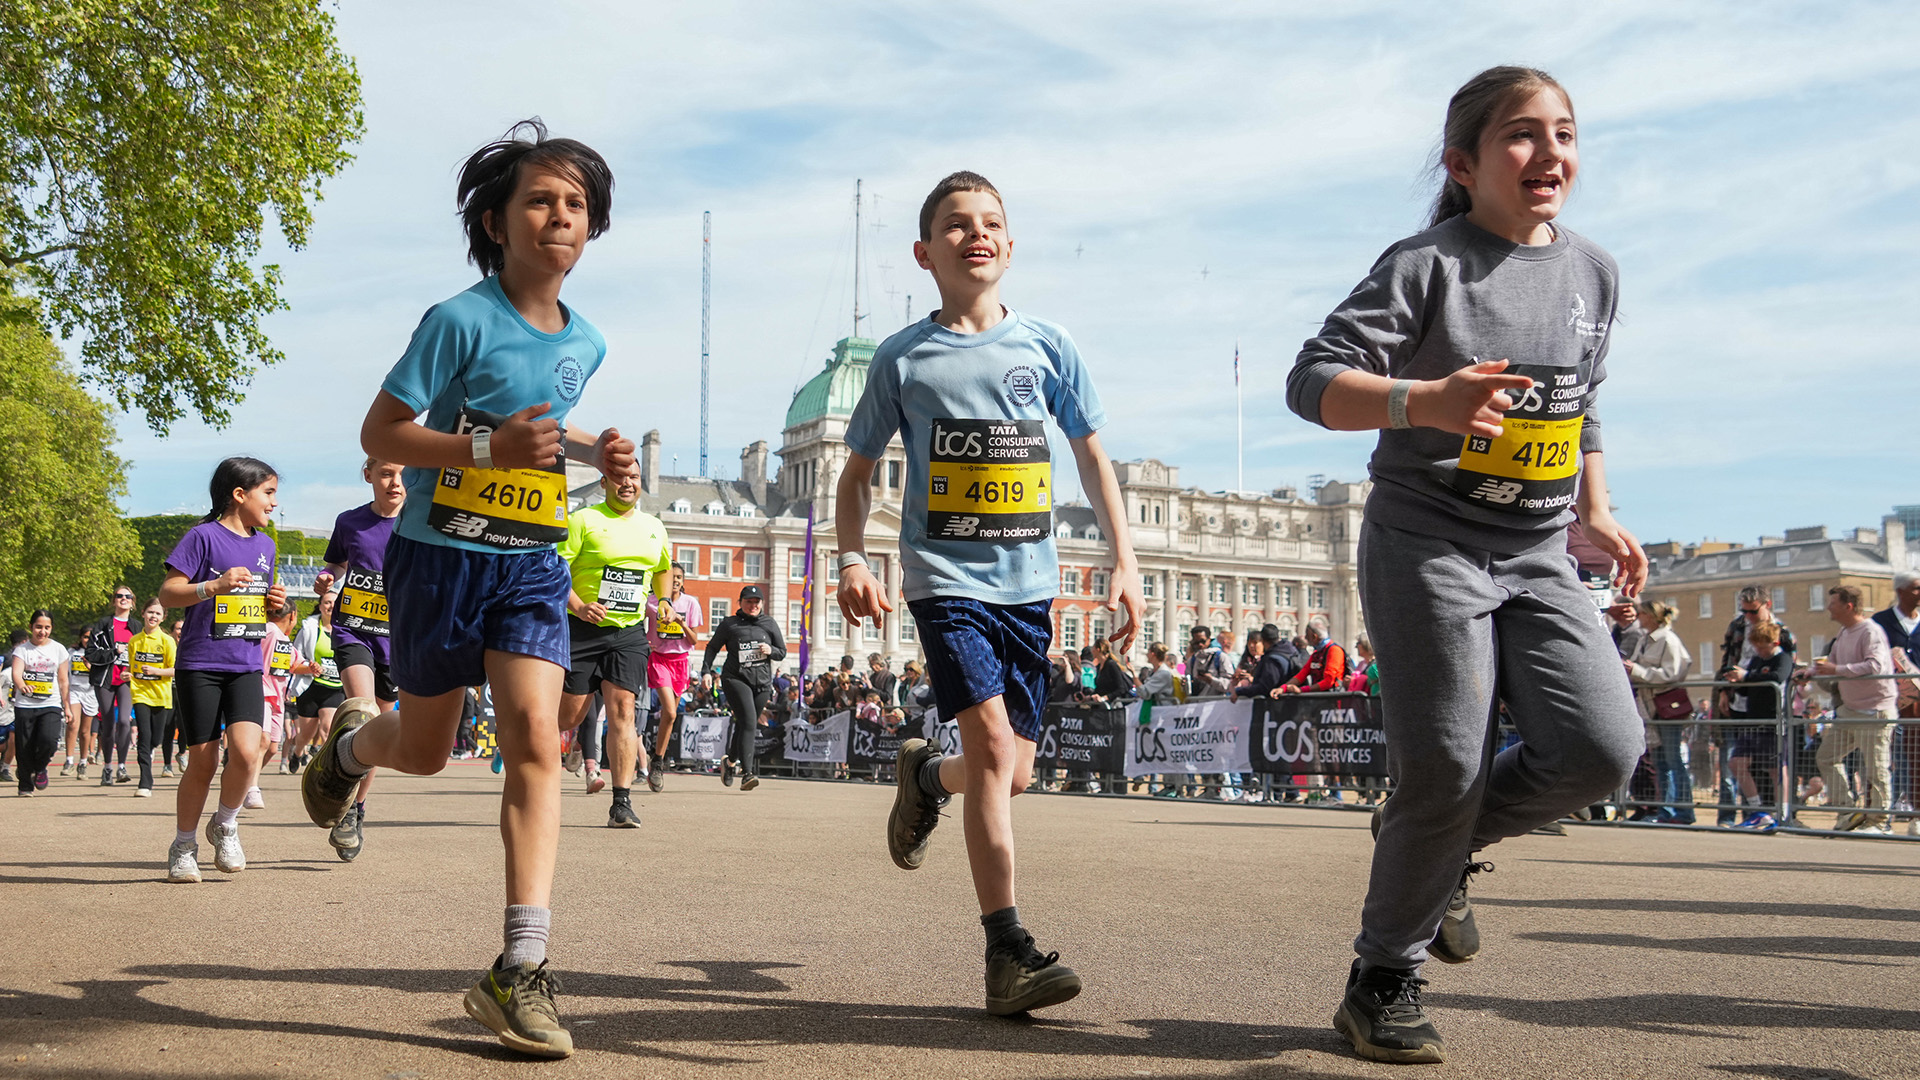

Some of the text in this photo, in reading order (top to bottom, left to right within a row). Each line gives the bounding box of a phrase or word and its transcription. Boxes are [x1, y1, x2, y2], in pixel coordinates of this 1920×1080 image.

[1554, 374, 1577, 386] TATA
[1547, 399, 1580, 413] SERVICES
[988, 425, 1018, 435] TATA
[934, 424, 982, 457] tcs
[988, 436, 1045, 446] CONSULTANCY
[1472, 440, 1487, 451] 13
[988, 448, 1029, 458] SERVICES
[1512, 441, 1570, 468] 4128
[444, 474, 458, 487] 13
[934, 484, 945, 493] 13
[965, 481, 1024, 503] 4619
[478, 481, 543, 512] 4610
[1519, 498, 1544, 508] new
[484, 532, 509, 544] new
[979, 527, 1040, 537] new balance
[347, 570, 373, 589] tcs
[605, 568, 623, 582] tcs
[608, 590, 635, 601] ADULT
[238, 605, 266, 617] 4129
[360, 601, 388, 616] 4119
[373, 626, 390, 634] balan
[1173, 716, 1200, 729] TATA
[1320, 708, 1357, 724] TATA
[1060, 733, 1114, 748] CONSULTANCY
[1171, 730, 1239, 747] CONSULTANCY
[1263, 710, 1314, 763] tcs
[1060, 748, 1091, 762] SERVICES
[1170, 748, 1214, 763] SERVICES
[1319, 748, 1371, 763] SERVICES
